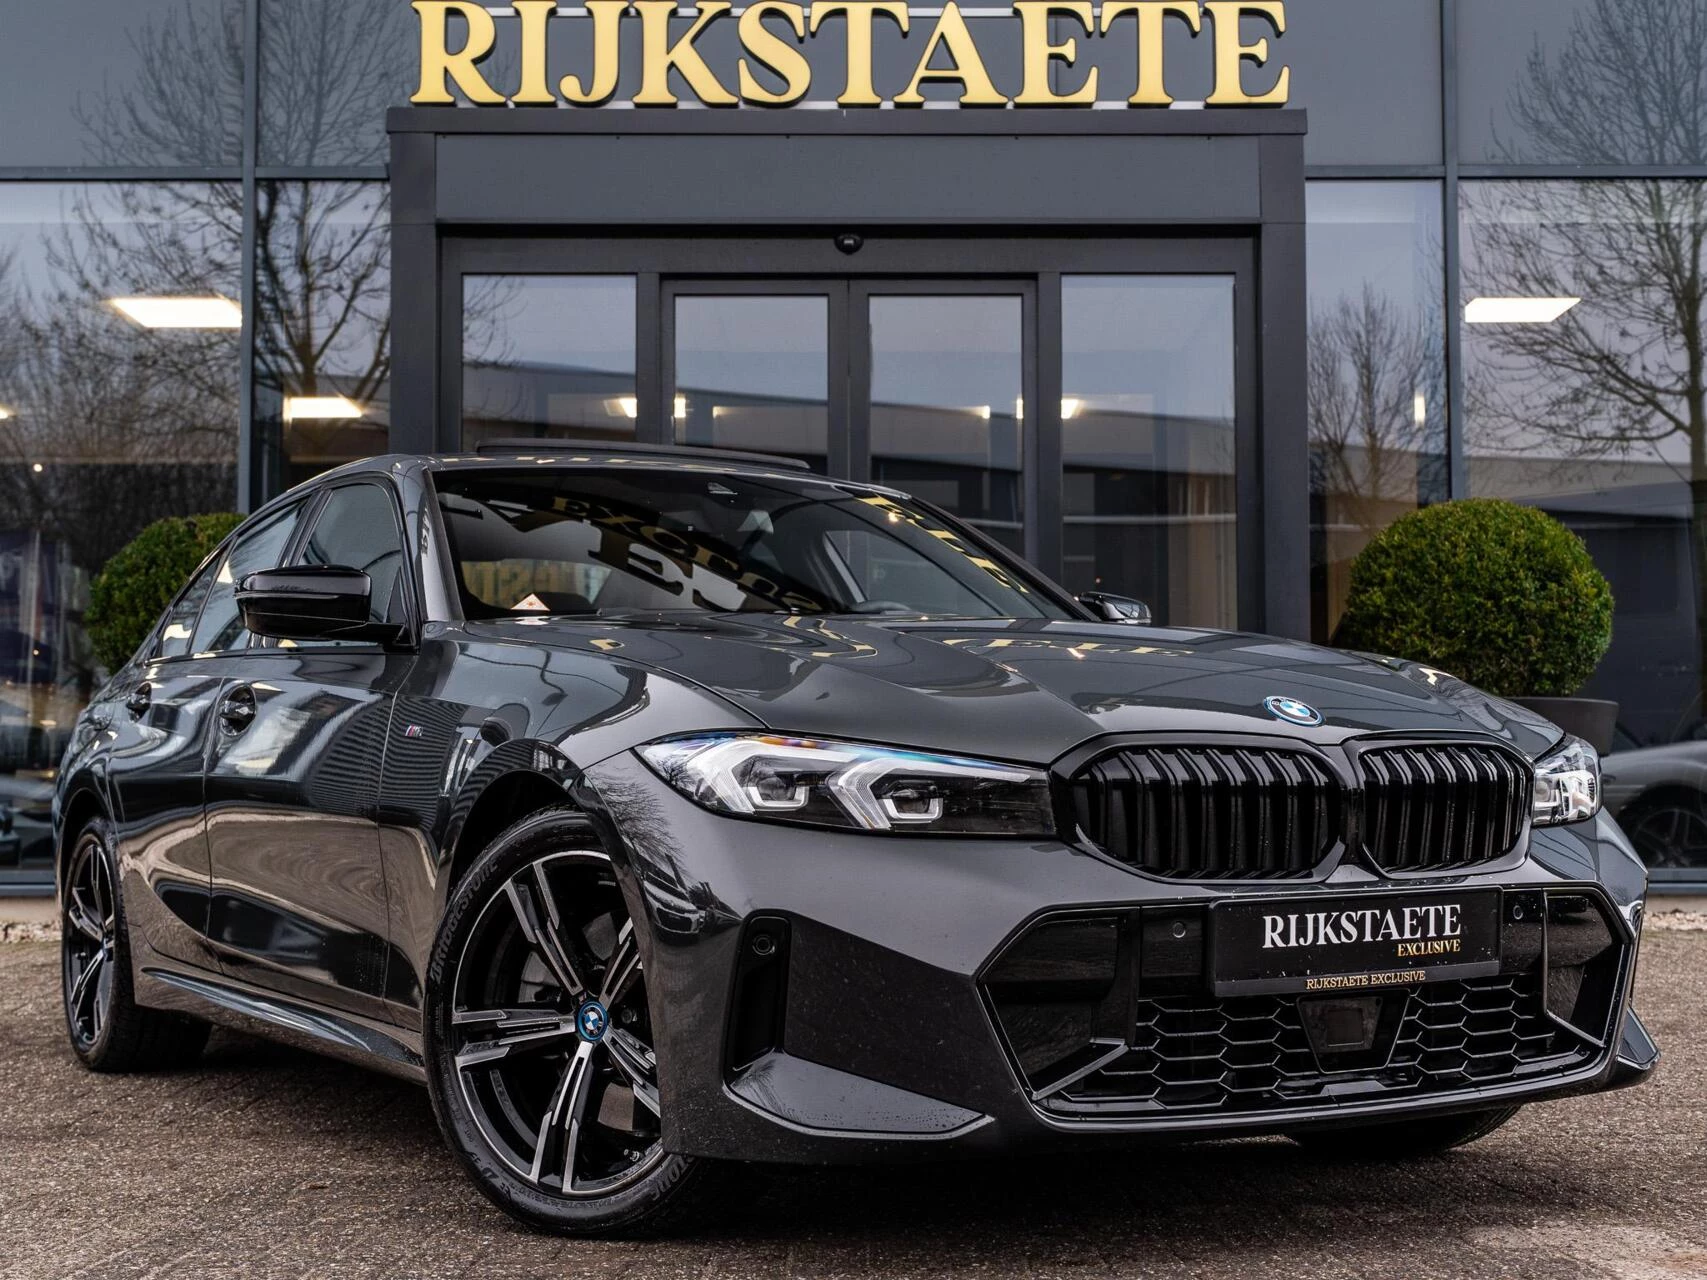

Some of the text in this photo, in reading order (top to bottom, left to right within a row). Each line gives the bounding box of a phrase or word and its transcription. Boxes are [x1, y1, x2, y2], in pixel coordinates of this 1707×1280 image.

[410, 0, 1291, 107] RIJKSTAETE
[1262, 904, 1462, 948] RIJKSTAETE
[1396, 938, 1462, 957] EXCLUSIVE
[1306, 970, 1427, 989] RIJKSTAETE EXCLUSIVE
